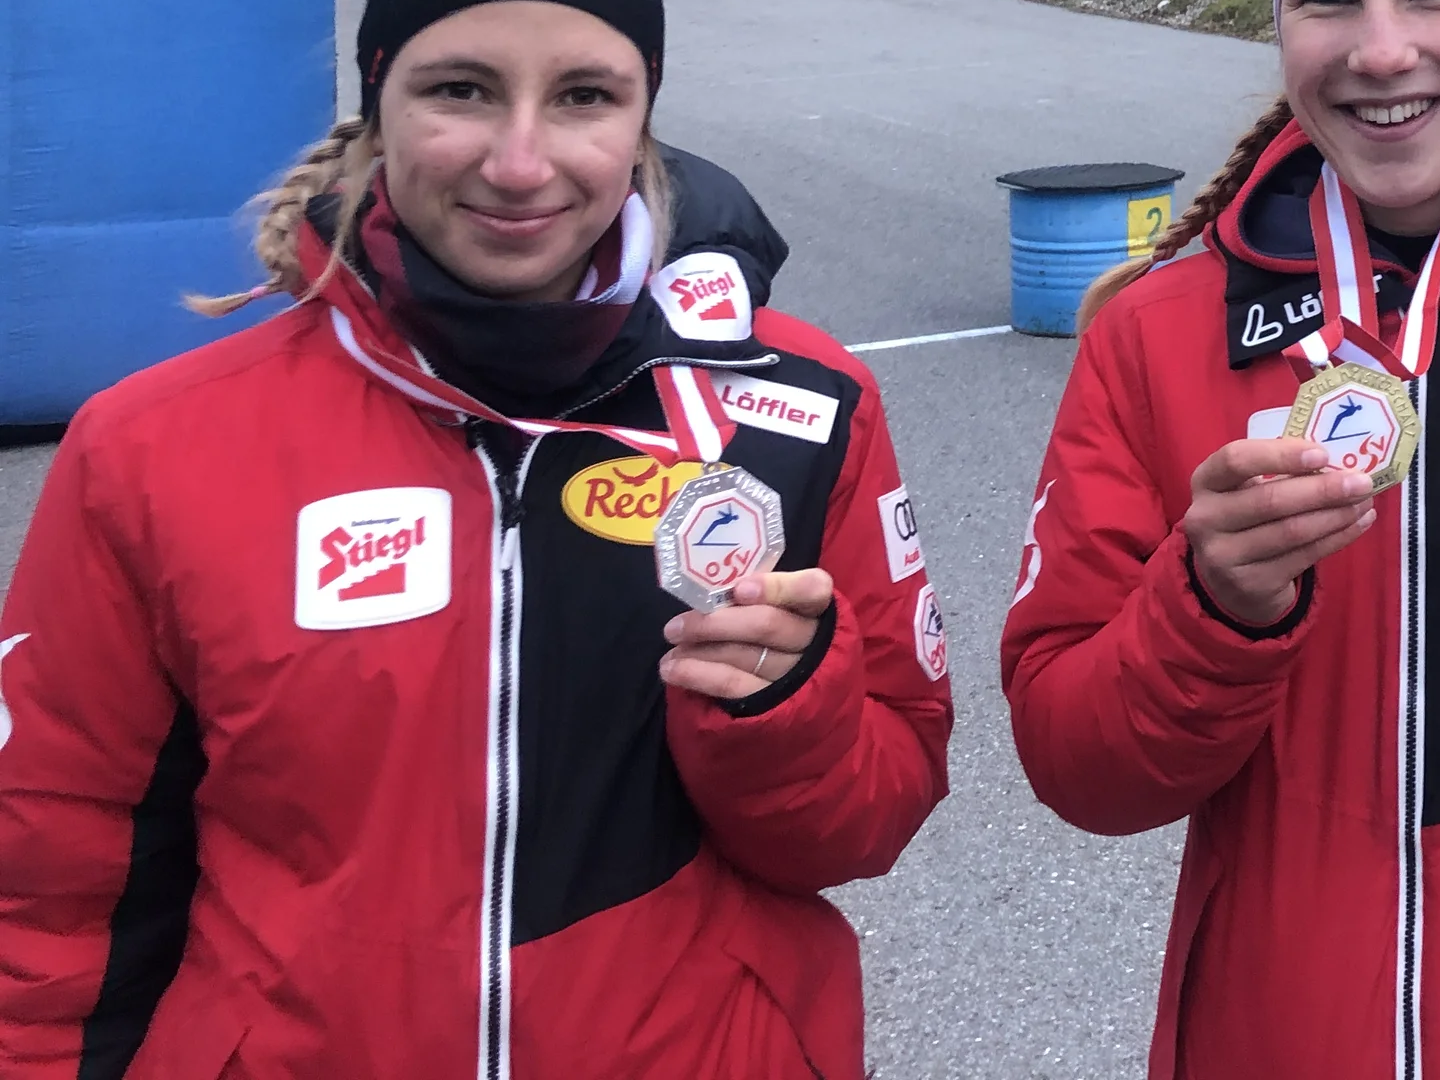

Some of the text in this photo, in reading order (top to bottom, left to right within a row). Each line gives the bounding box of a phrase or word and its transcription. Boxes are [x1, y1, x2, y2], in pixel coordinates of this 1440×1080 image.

[1146, 207, 1162, 244] 2
[668, 272, 735, 312] Stiegl
[722, 385, 820, 428] Löffler
[584, 476, 677, 519] Rech
[318, 516, 426, 590] Stiegl
